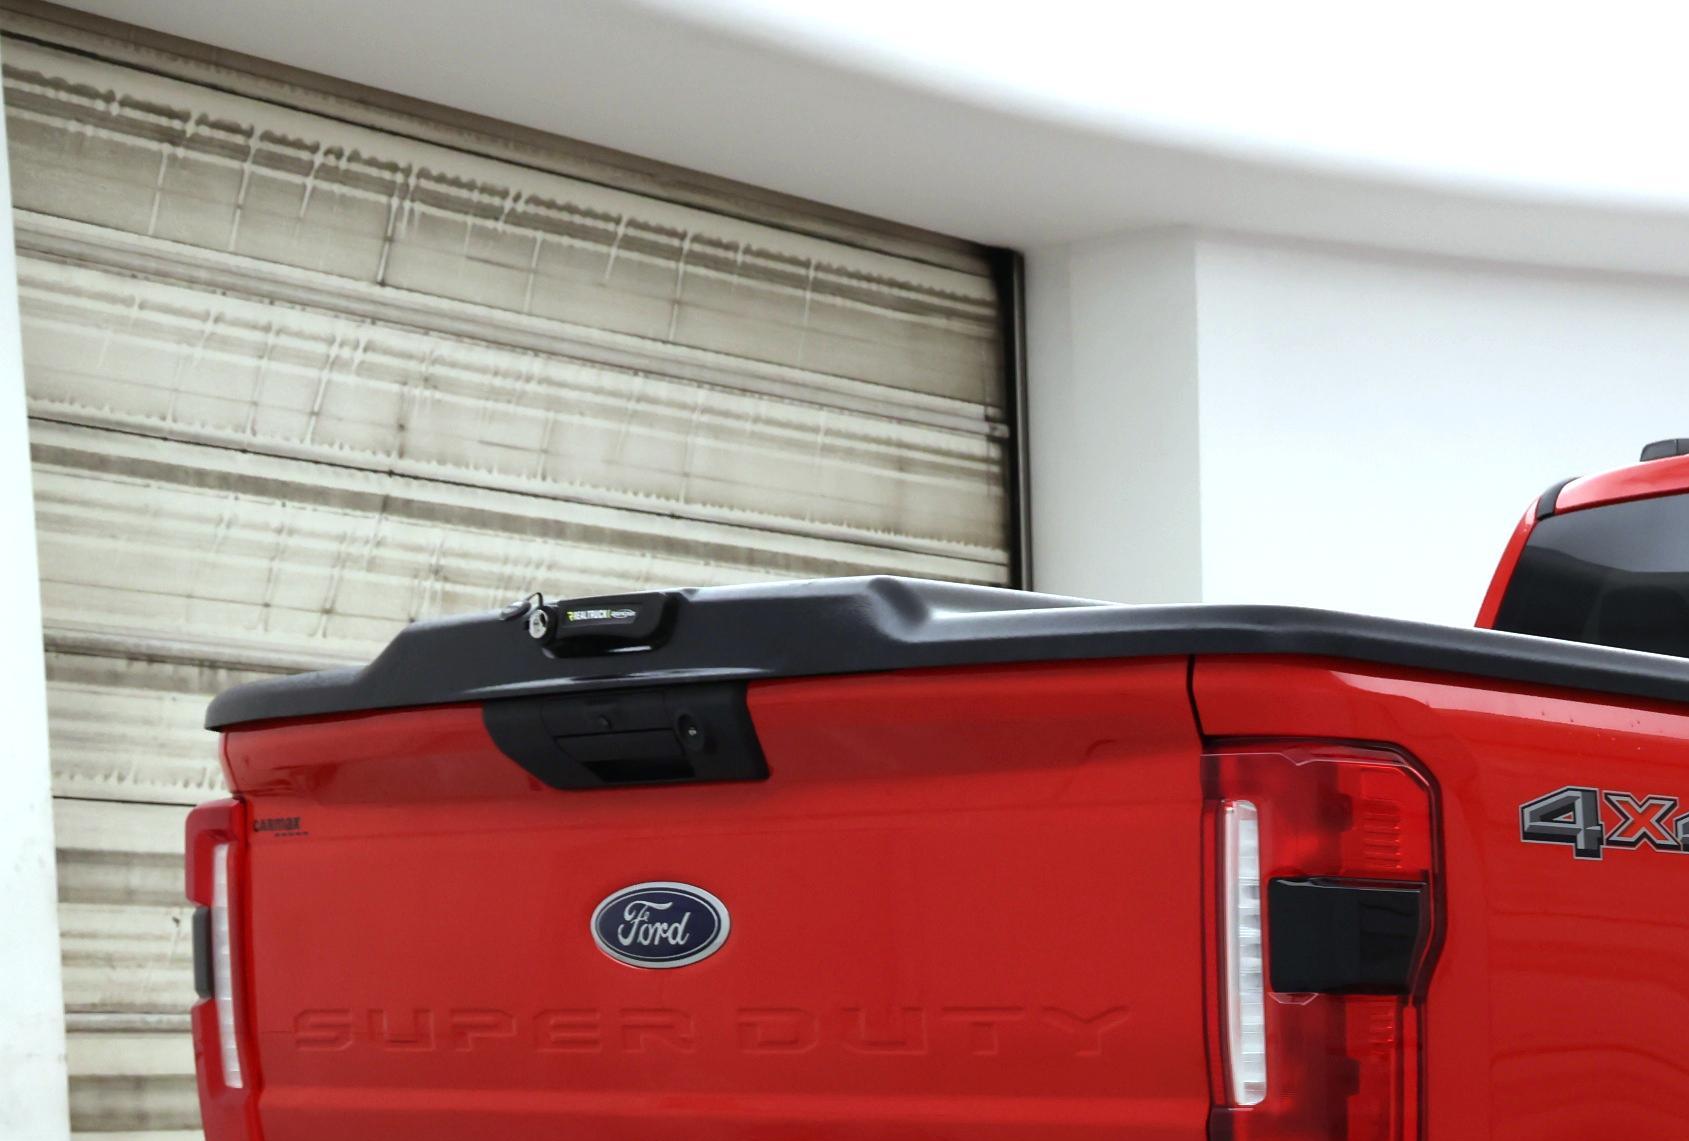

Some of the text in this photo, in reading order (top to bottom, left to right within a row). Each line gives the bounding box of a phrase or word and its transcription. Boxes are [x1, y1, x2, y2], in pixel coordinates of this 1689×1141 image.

[617, 900, 691, 946] Ford
[295, 1006, 1130, 1057] SUPER DUTY
